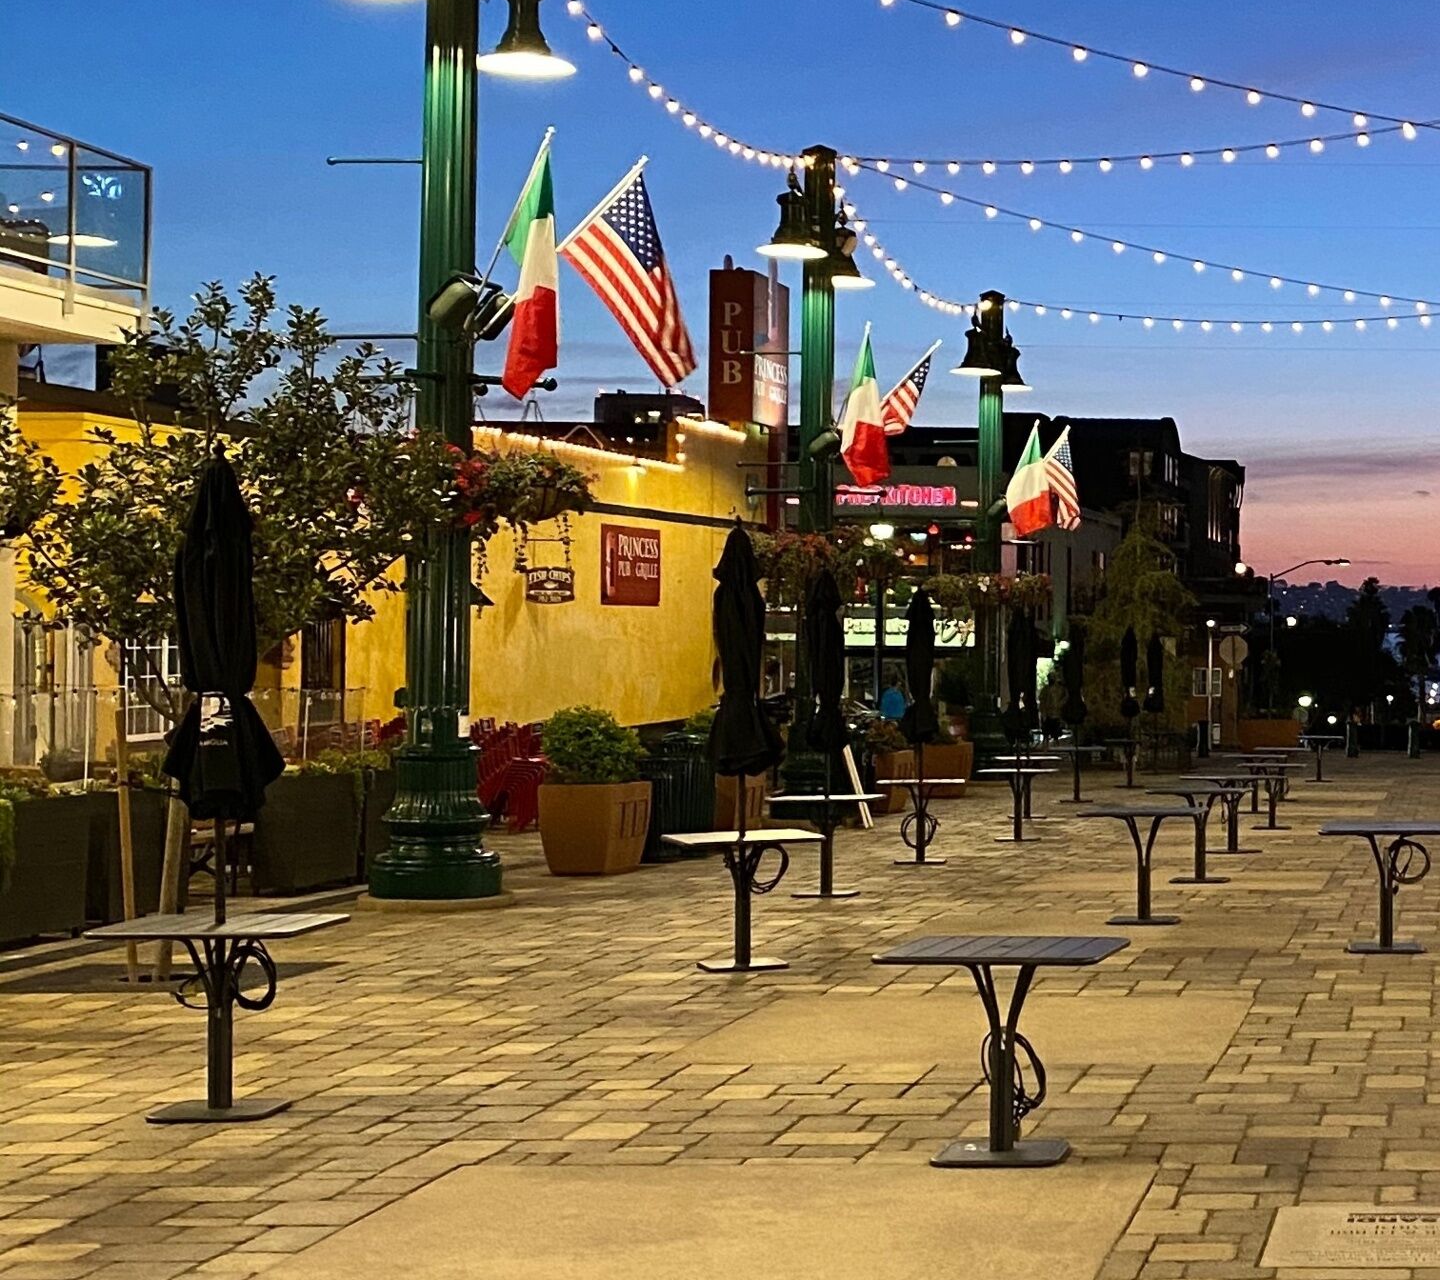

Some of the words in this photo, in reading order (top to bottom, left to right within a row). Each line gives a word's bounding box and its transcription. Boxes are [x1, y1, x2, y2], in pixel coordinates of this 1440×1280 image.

[721, 301, 742, 384] PUB
[754, 354, 789, 385] PRINCESS
[882, 485, 957, 506] KITCHEN
[618, 534, 659, 560] PRINCESS
[618, 560, 632, 577] PUB
[635, 562, 659, 580] GRILLE
